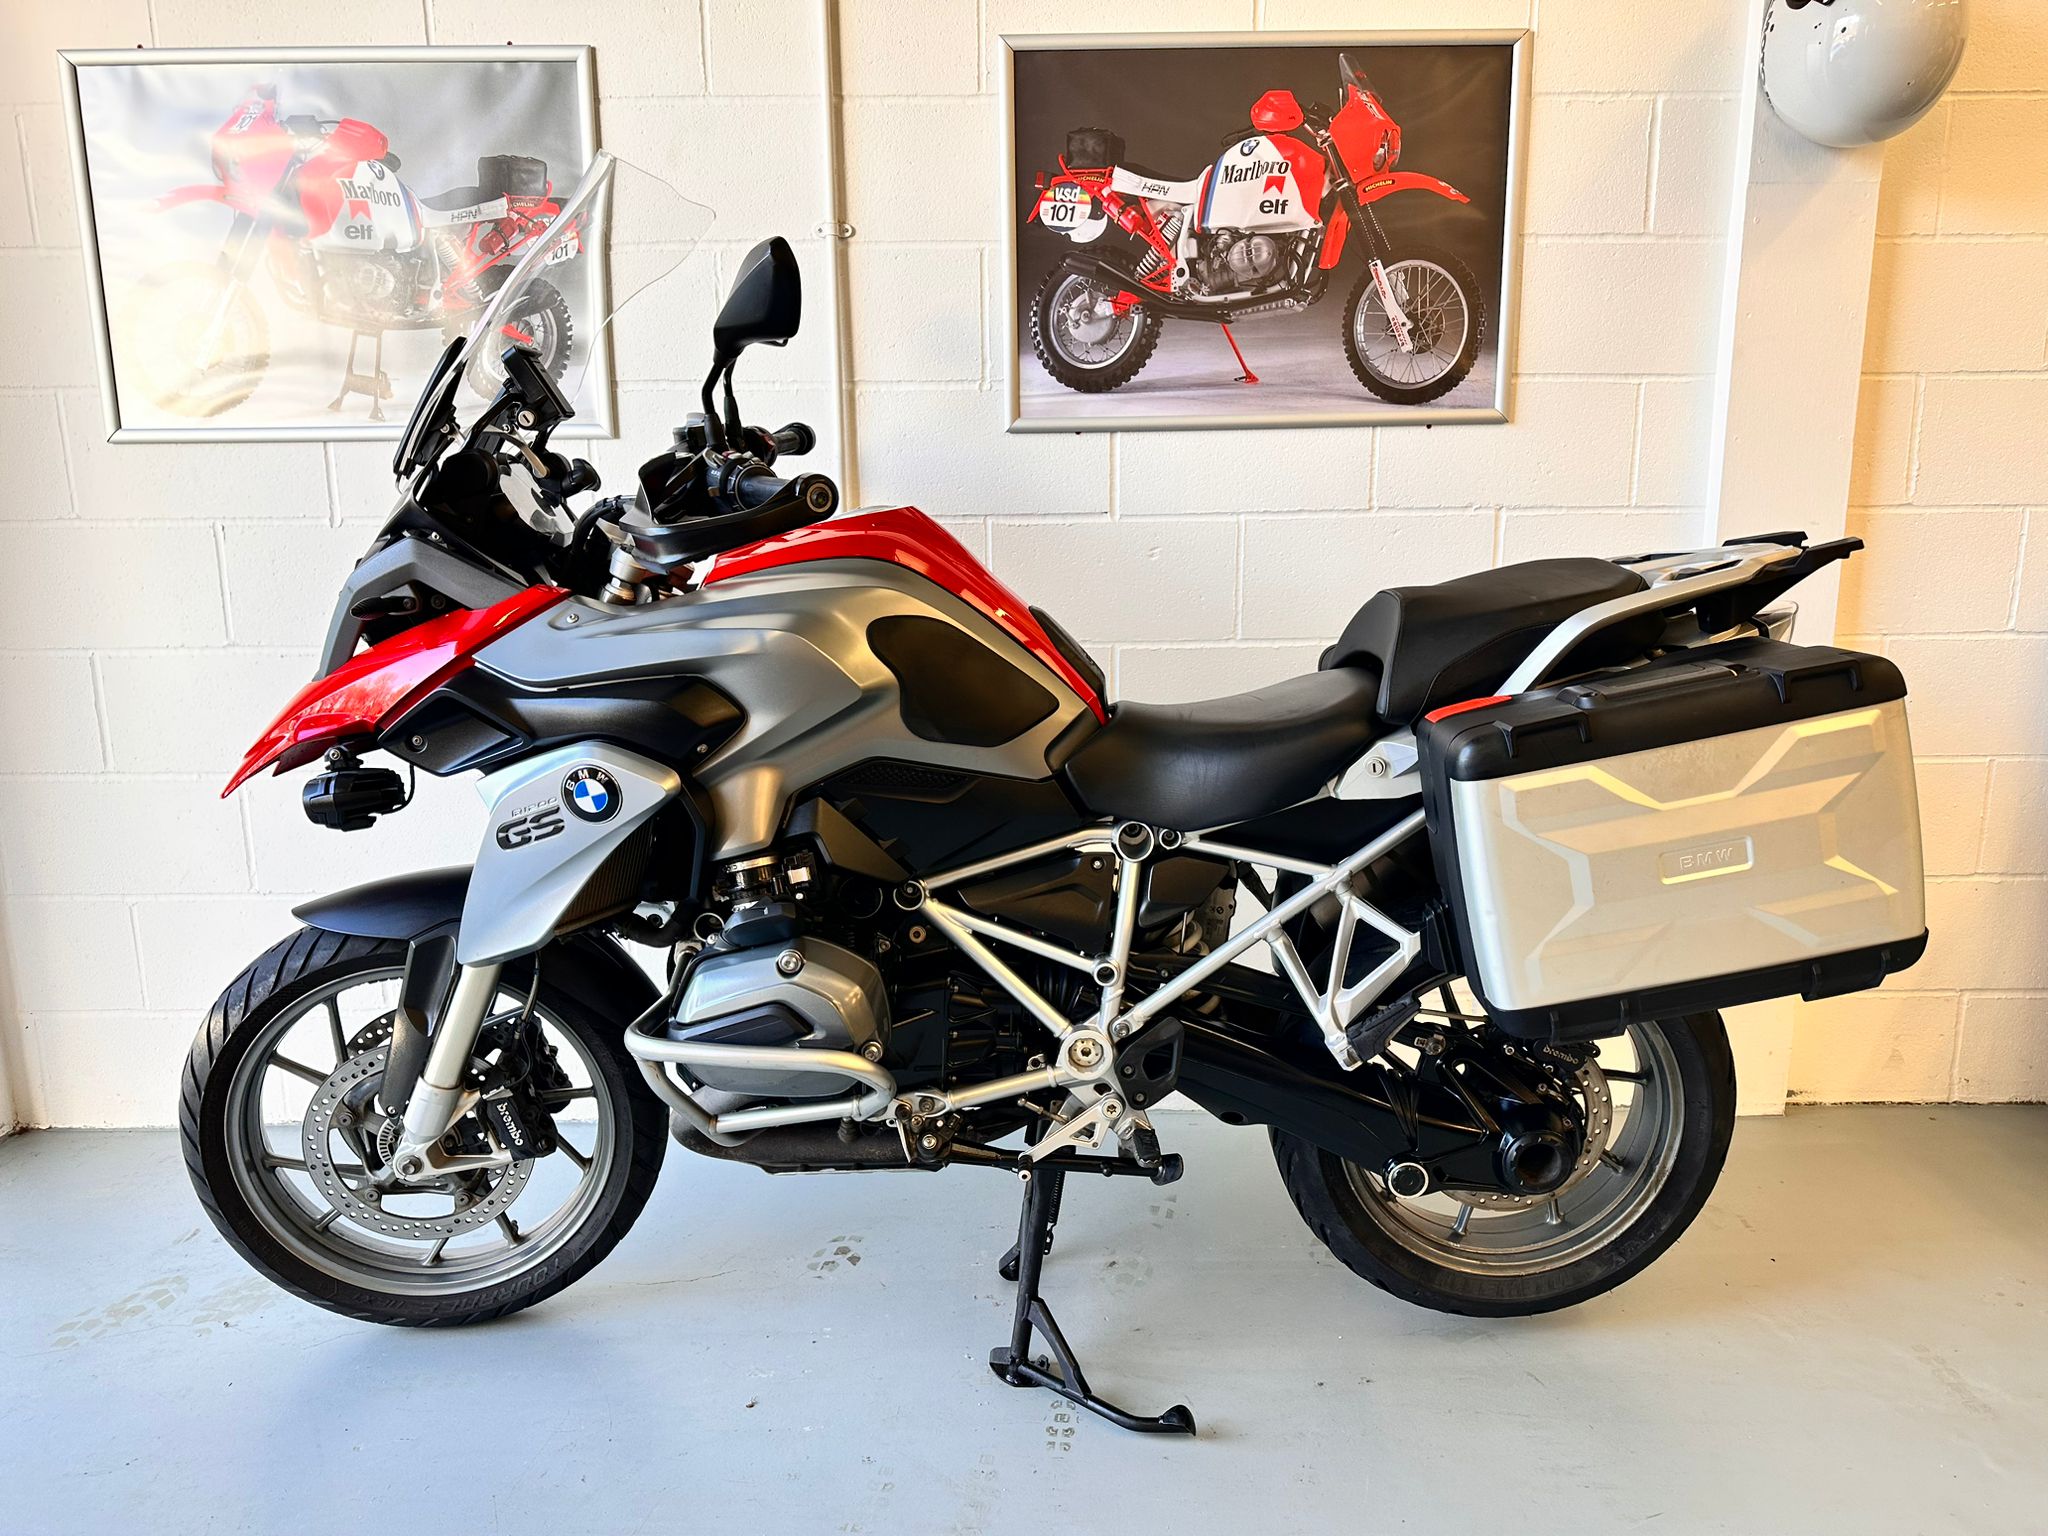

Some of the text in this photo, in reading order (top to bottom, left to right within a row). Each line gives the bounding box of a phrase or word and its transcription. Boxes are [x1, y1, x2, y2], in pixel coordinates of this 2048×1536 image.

[1220, 160, 1290, 184] Marlboro
[340, 179, 401, 207] Marlboro
[1141, 182, 1170, 196] HPN
[1365, 179, 1393, 192] MICHELIN
[1050, 204, 1076, 222] 101
[1259, 198, 1289, 214] elf
[343, 224, 373, 240] elf
[565, 769, 609, 792] BMW
[496, 805, 566, 851] GS
[1679, 847, 1733, 870] BMW
[1542, 1044, 1579, 1065] brembo
[496, 1101, 524, 1146] brembo
